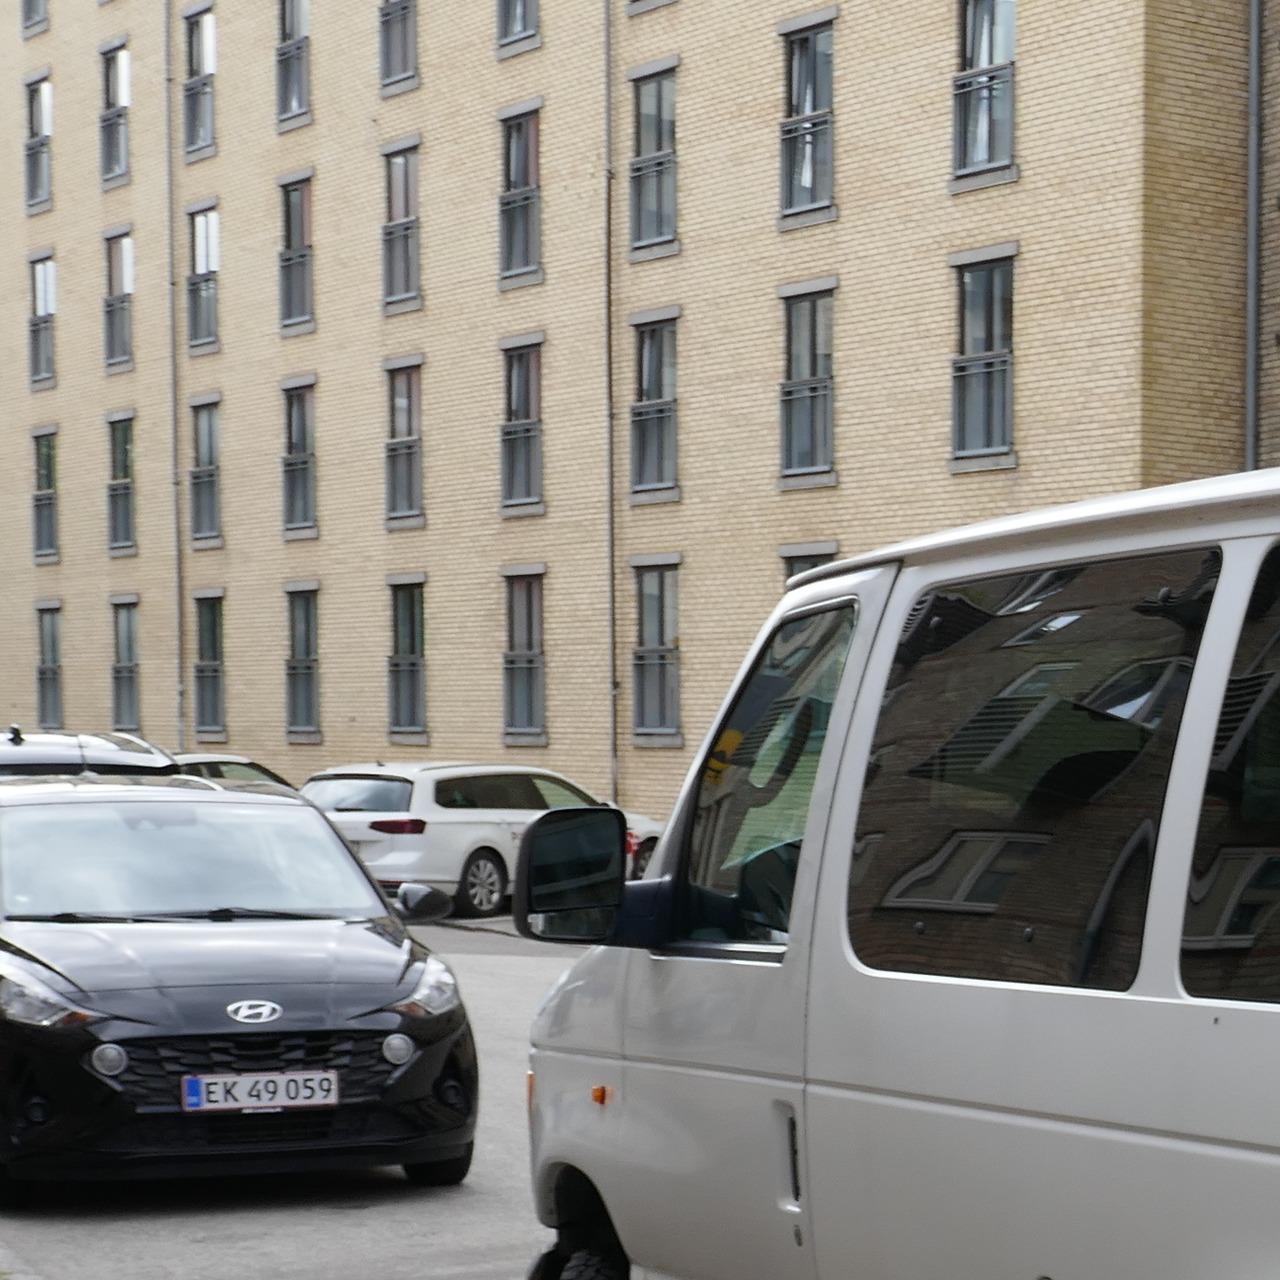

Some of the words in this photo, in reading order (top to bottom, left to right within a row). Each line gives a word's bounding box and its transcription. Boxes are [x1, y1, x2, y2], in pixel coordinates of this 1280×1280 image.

[205, 1081, 240, 1104] EK
[248, 1079, 279, 1102] 49
[286, 1077, 333, 1100] 059
